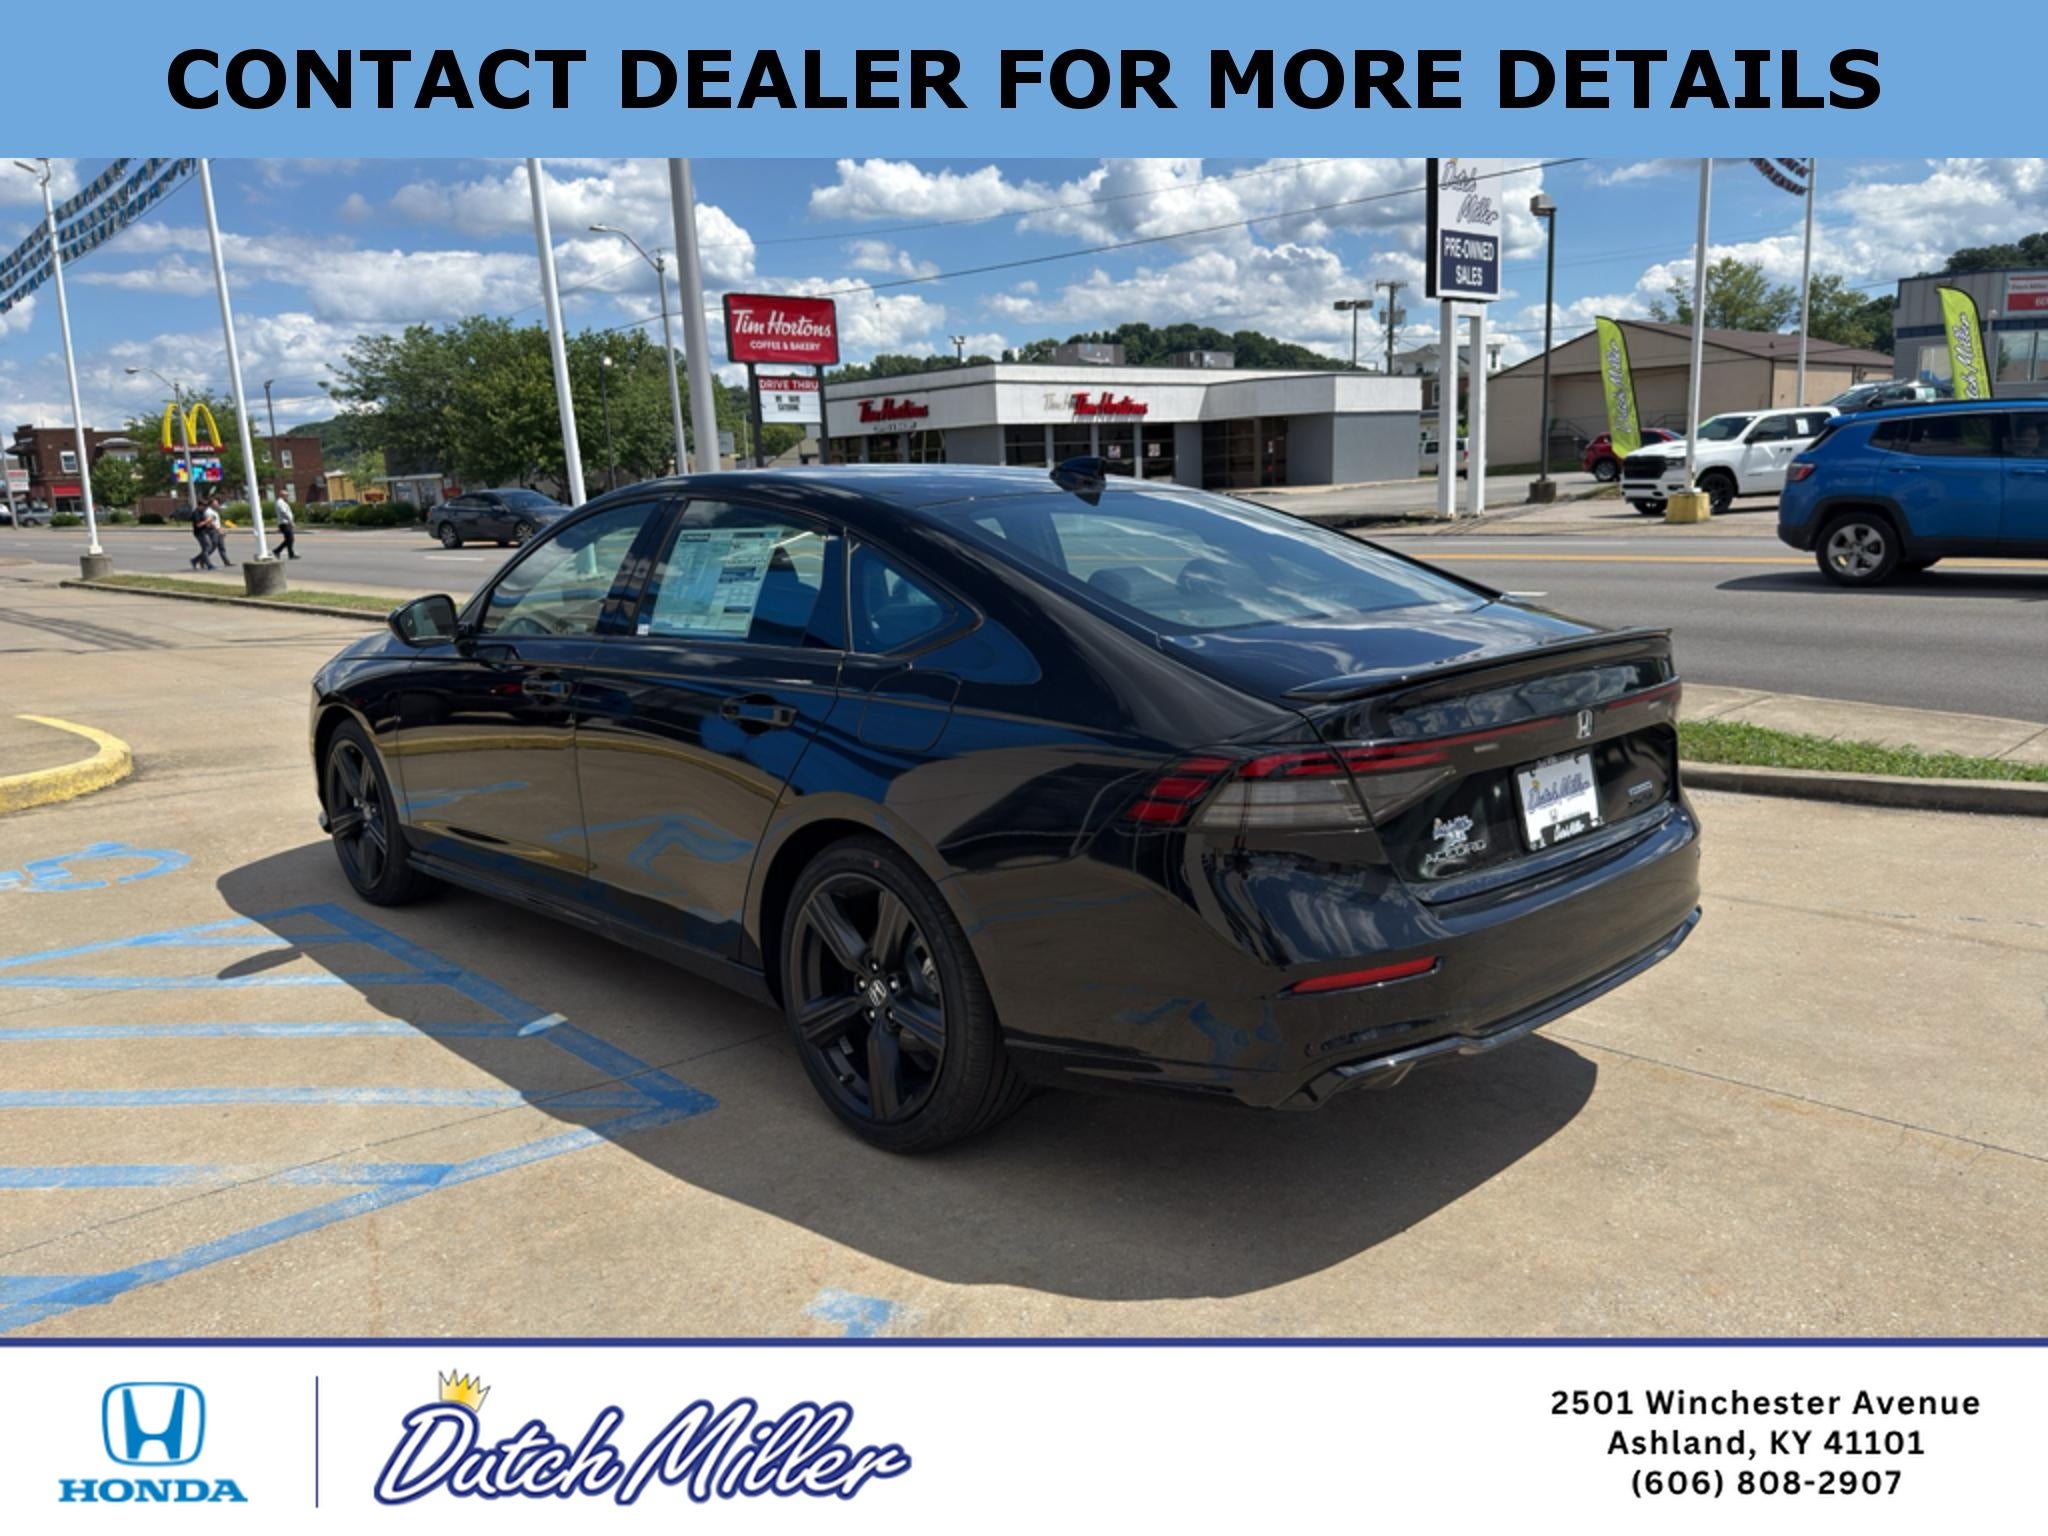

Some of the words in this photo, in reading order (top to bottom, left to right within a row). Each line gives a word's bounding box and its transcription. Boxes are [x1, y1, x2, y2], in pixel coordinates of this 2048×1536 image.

[1456, 193, 1499, 225] Miller
[1444, 237, 1495, 261] PRE-OWNED
[1455, 265, 1483, 286] SALES
[732, 309, 765, 334] Tim
[767, 309, 832, 337] Hortons
[749, 340, 780, 350] COFFEE
[790, 341, 821, 351] BAKERY
[760, 380, 790, 390] DRIVE
[792, 379, 819, 390] THRU
[1425, 840, 1487, 864] ACCORD
